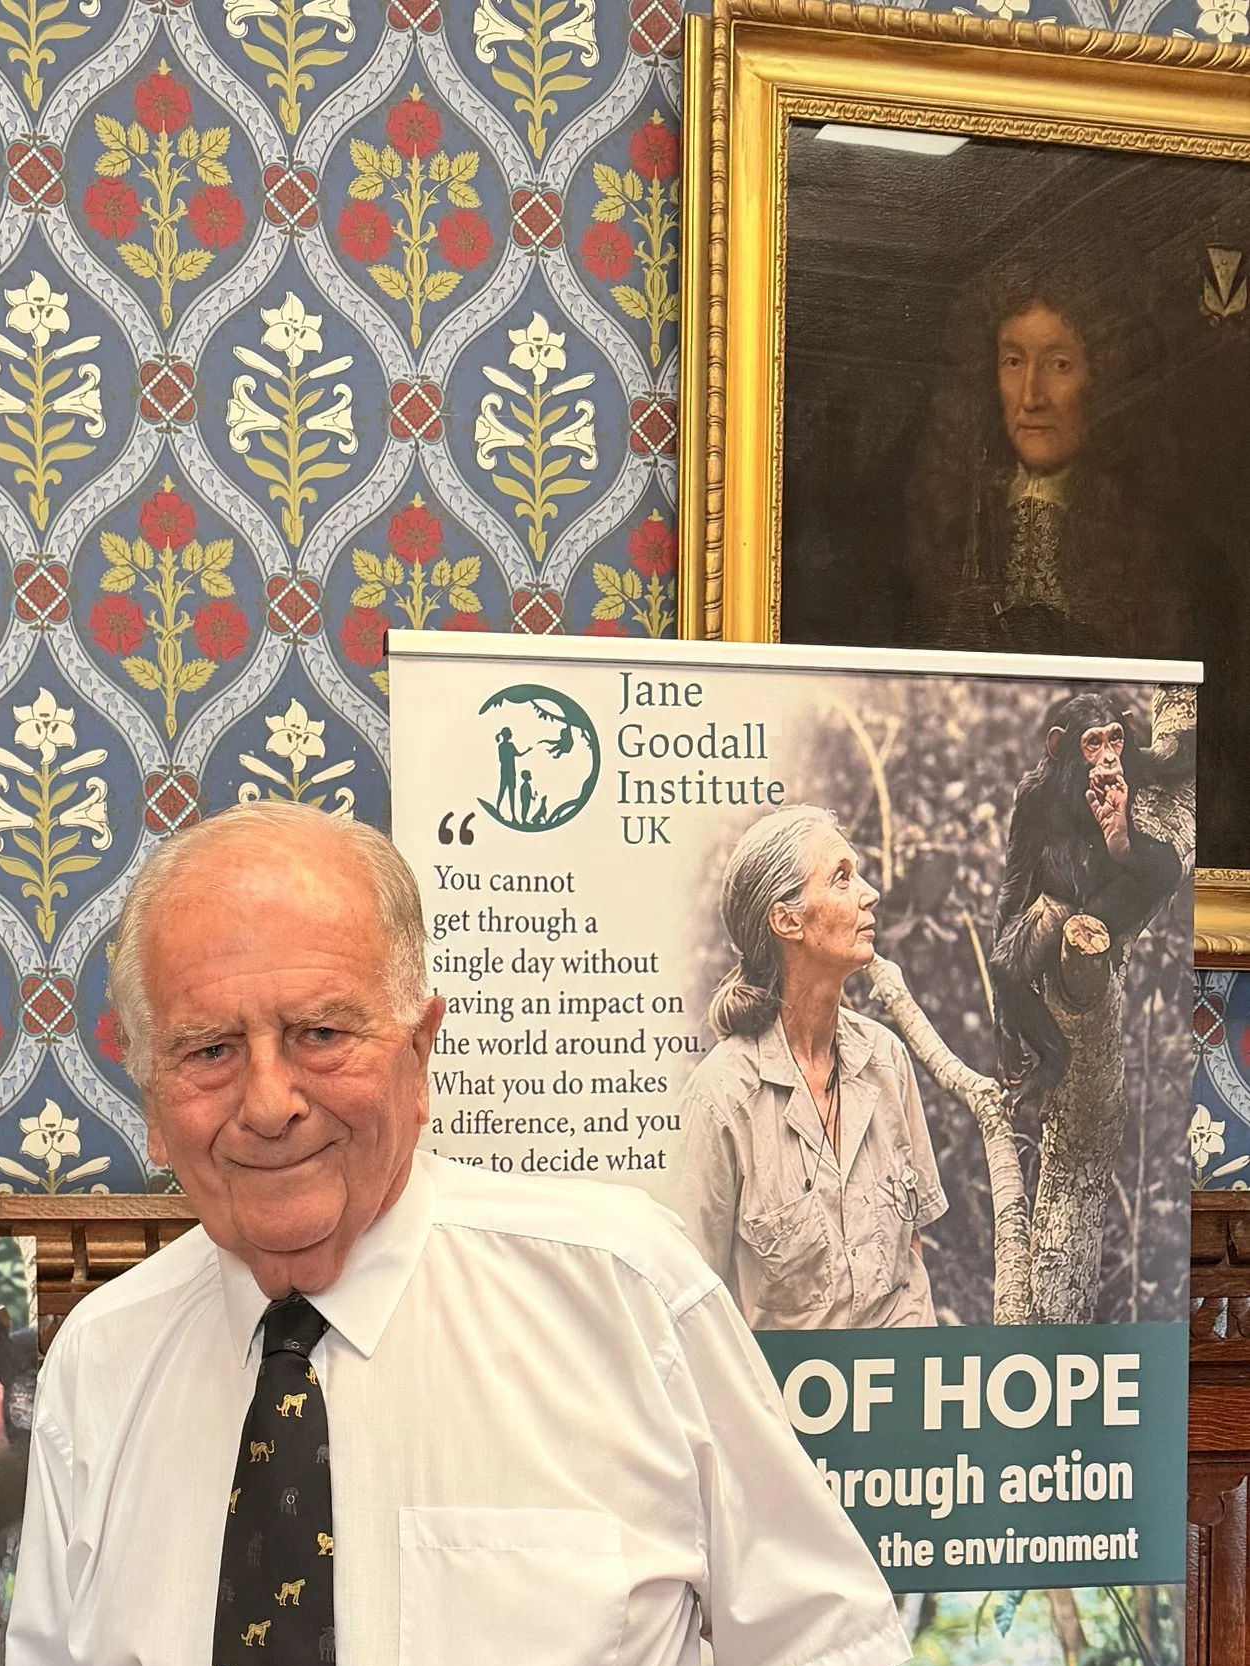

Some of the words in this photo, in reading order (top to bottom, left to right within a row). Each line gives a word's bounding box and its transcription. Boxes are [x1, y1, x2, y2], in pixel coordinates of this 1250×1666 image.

[618, 672, 703, 714] Jane
[617, 721, 769, 761] Goodall
[617, 770, 785, 807] Institute
[621, 816, 672, 845] UK
[433, 865, 481, 891] You
[490, 872, 575, 893] cannot
[433, 910, 470, 940] get
[478, 906, 577, 942] through
[585, 916, 598, 933] a
[433, 947, 503, 982] single
[511, 948, 554, 981] day
[561, 949, 659, 976] without
[521, 996, 551, 1015] an
[558, 990, 645, 1023] impact
[652, 996, 684, 1015] on
[433, 1029, 470, 1055] the
[477, 1028, 548, 1056] world
[555, 1029, 646, 1055] around
[653, 1035, 707, 1065] you.
[432, 1070, 495, 1096] What
[502, 1076, 546, 1102] you
[552, 1069, 583, 1096] do
[590, 1069, 668, 1094] makes
[432, 1116, 444, 1135] a
[451, 1109, 576, 1138] difference,
[583, 1108, 629, 1133] and
[636, 1113, 682, 1140] you
[491, 1152, 513, 1173] to
[521, 1147, 600, 1173] decide
[605, 1146, 667, 1171] what
[783, 1358, 896, 1436] OF
[924, 1353, 1141, 1430] HOPE
[999, 1449, 1133, 1504] action
[878, 1532, 935, 1568] the
[944, 1527, 1139, 1566] environment
